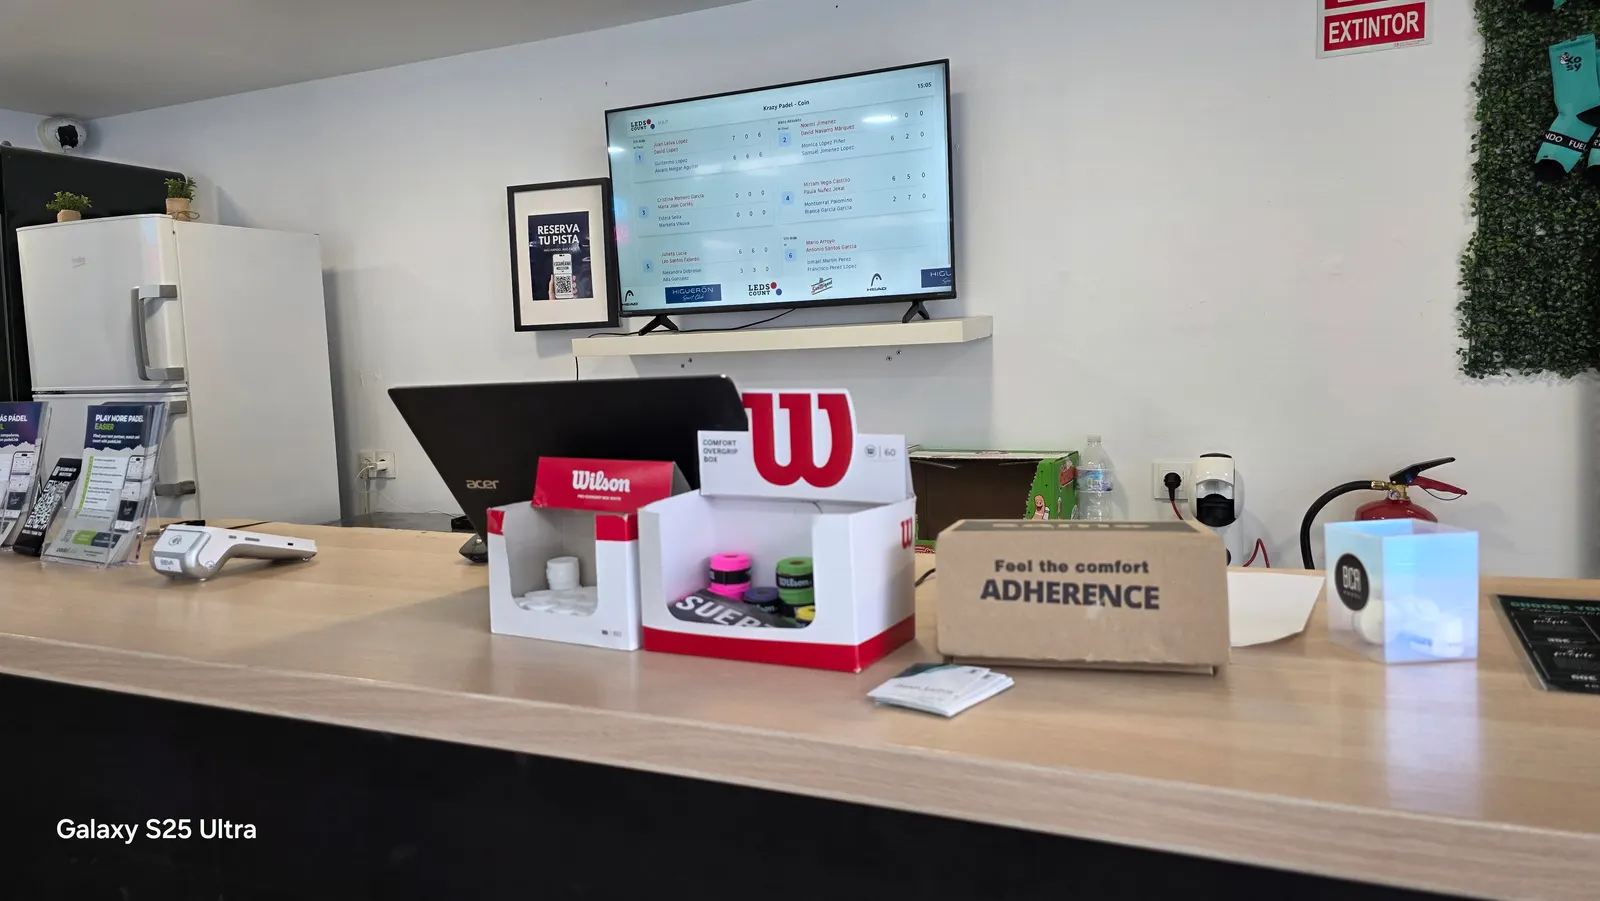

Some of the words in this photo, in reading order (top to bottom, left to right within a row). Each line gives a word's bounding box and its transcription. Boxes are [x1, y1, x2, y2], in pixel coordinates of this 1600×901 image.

[1329, 10, 1419, 44] EXTINTOR
[538, 224, 580, 234] RESERVA
[538, 236, 550, 245] TU
[553, 235, 579, 244] PISTA
[8, 413, 27, 422] PÁDEL
[741, 392, 853, 487] W
[885, 448, 896, 457] 60
[466, 480, 499, 489] acer
[572, 470, 630, 493] Wilson
[995, 560, 1032, 573] Feel
[1040, 560, 1068, 573] the
[1075, 560, 1149, 574] comfort
[981, 579, 1160, 610] ADHERENCE
[676, 595, 775, 628] SUER
